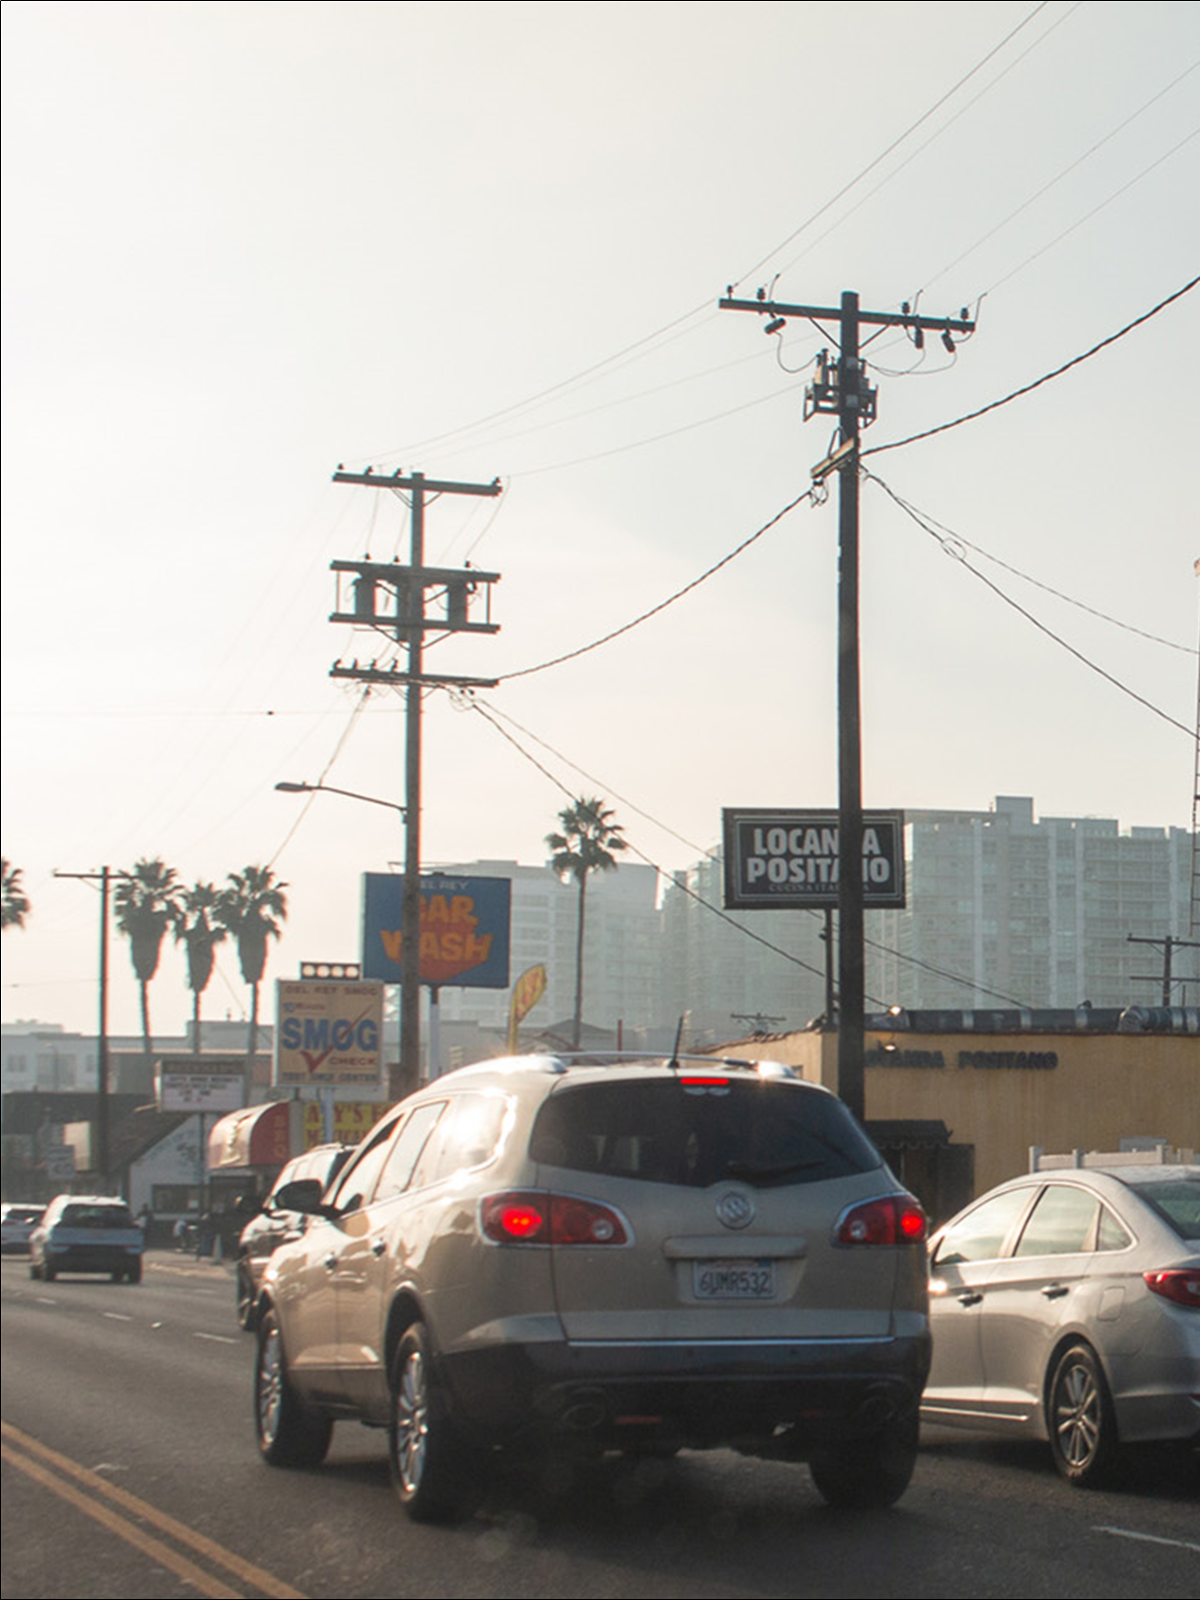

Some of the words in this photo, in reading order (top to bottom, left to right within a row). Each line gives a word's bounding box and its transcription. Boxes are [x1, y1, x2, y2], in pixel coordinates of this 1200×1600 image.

[753, 827, 881, 856] LOCANA
[746, 857, 891, 883] POSITO
[282, 1017, 378, 1051] SMOG
[328, 1057, 377, 1066] CHECK
